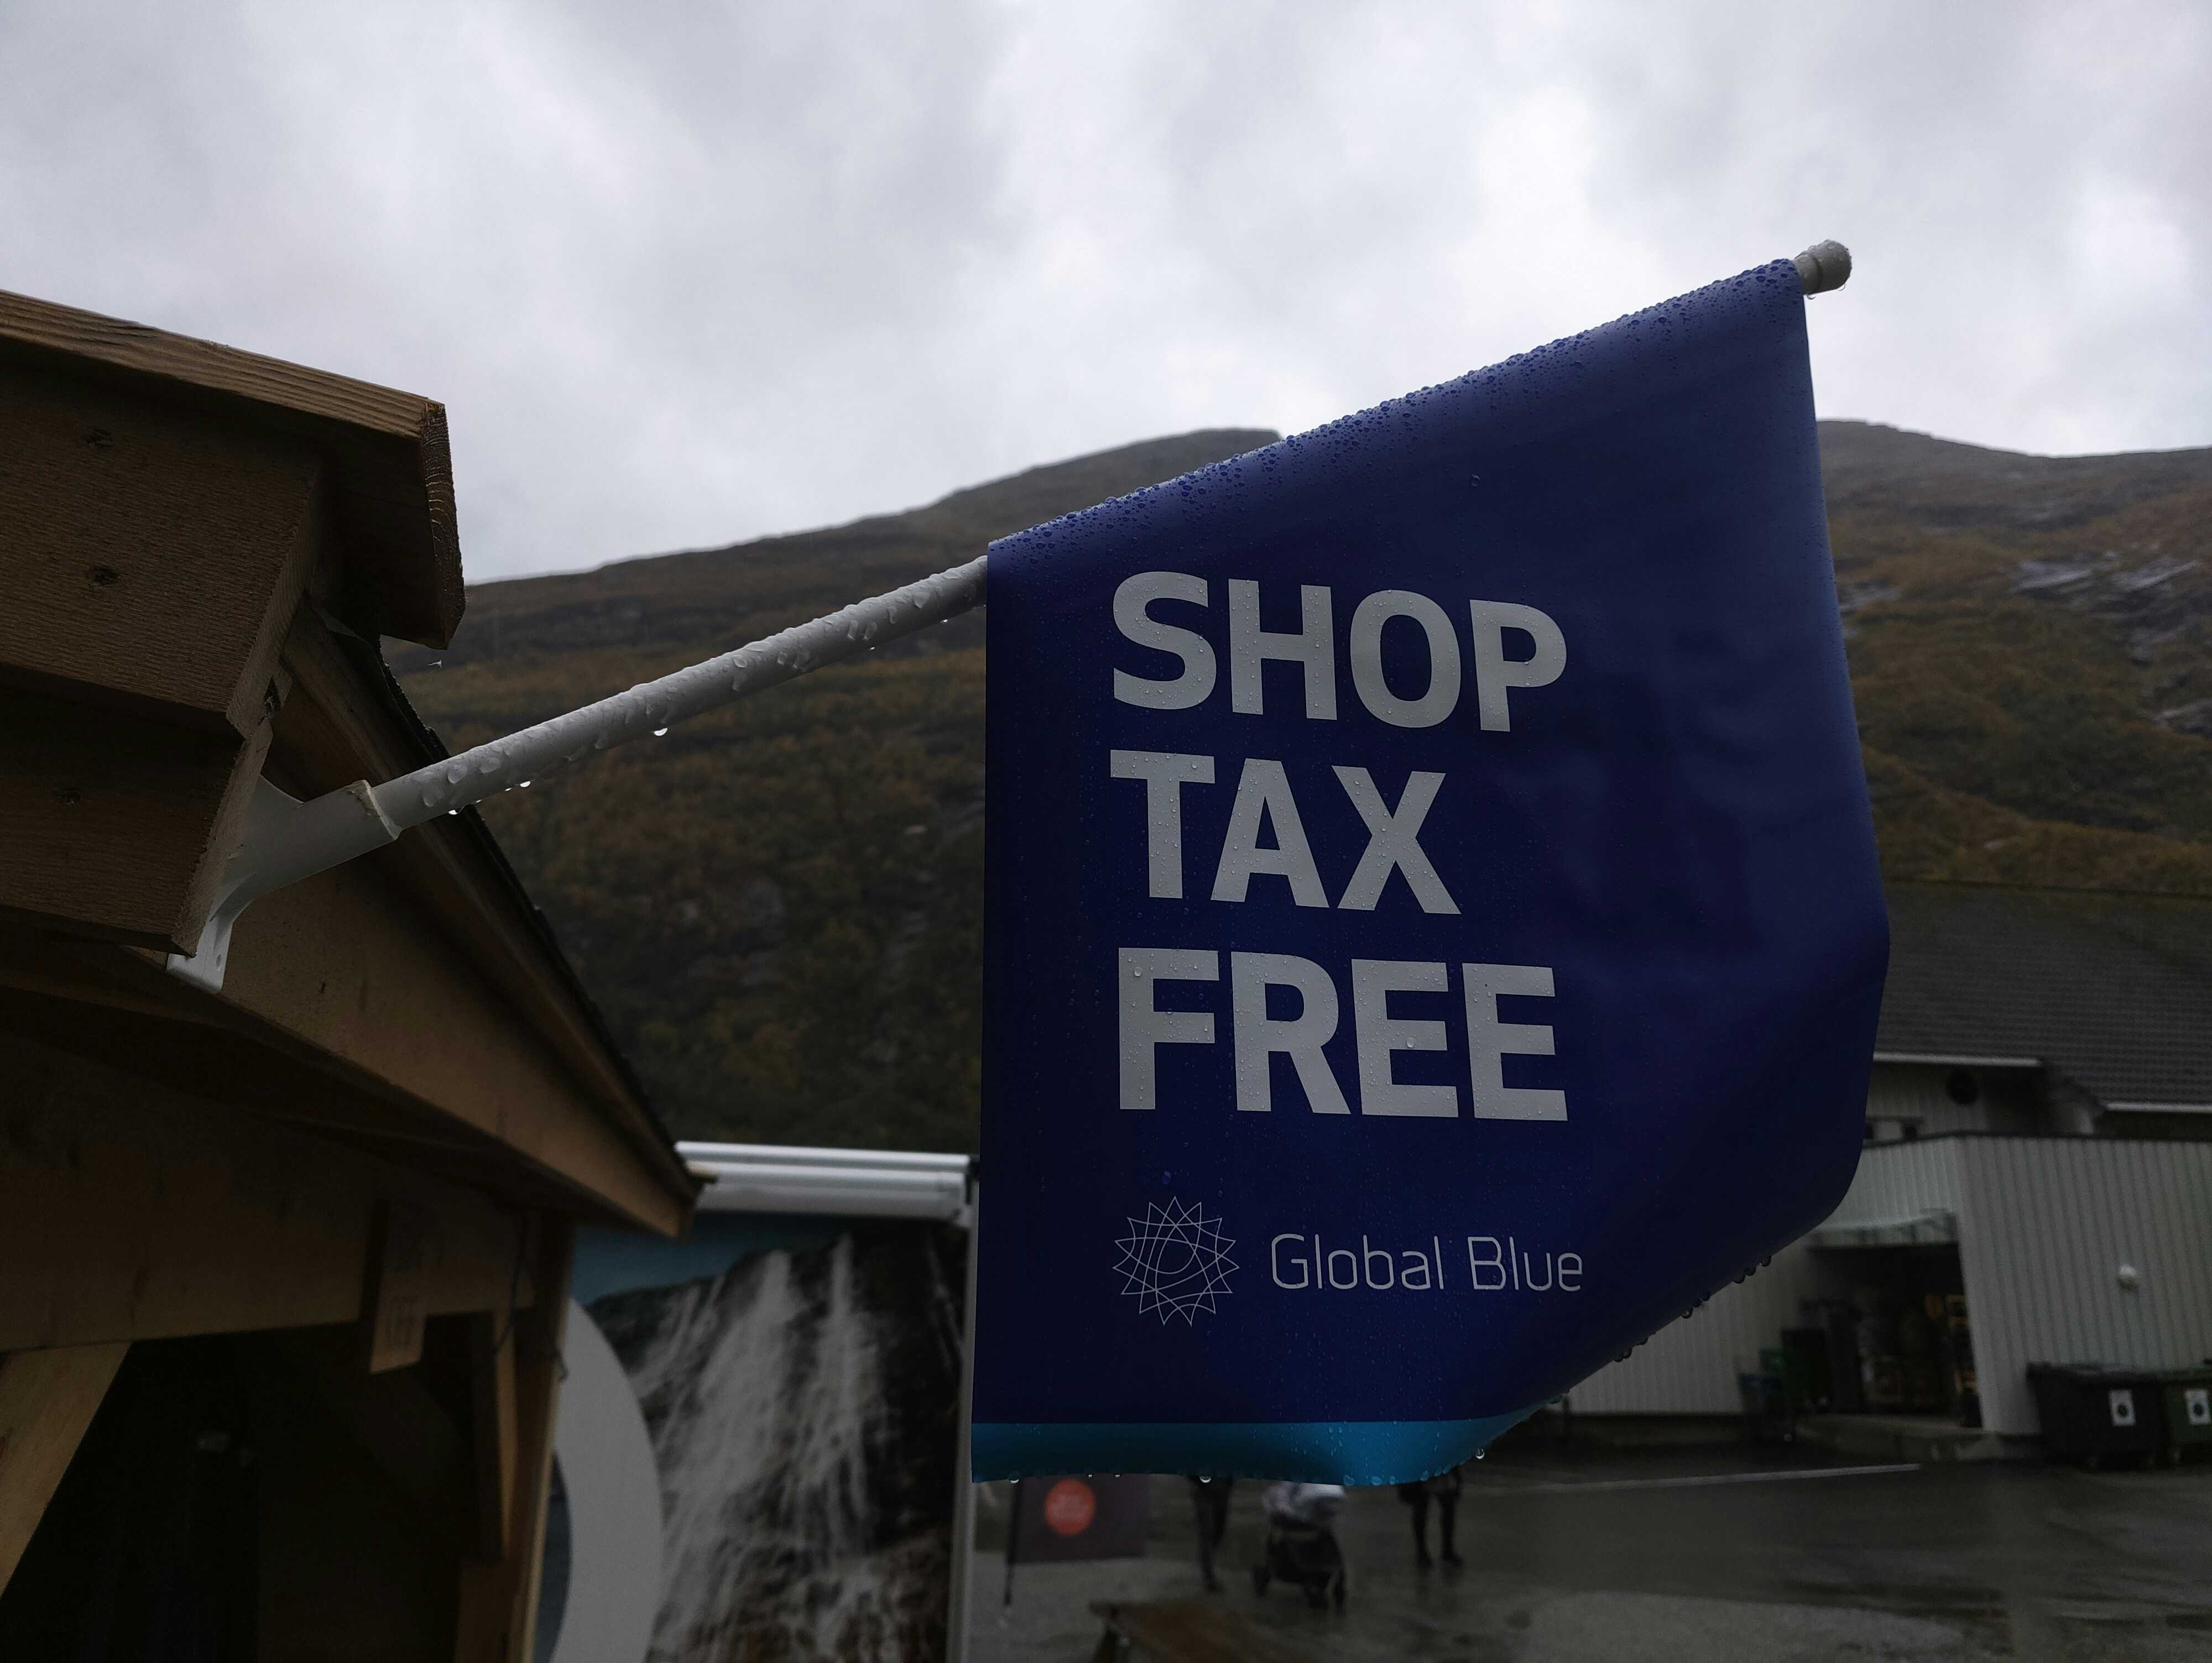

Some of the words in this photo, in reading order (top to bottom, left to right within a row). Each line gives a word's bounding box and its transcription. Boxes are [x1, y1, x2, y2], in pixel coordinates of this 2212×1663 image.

[1112, 571, 1567, 733] SHOP
[1109, 749, 1461, 915] TAX
[1118, 947, 1568, 1122] FREE
[1271, 1233, 1444, 1290] Global
[1467, 1236, 1584, 1291] Blue
